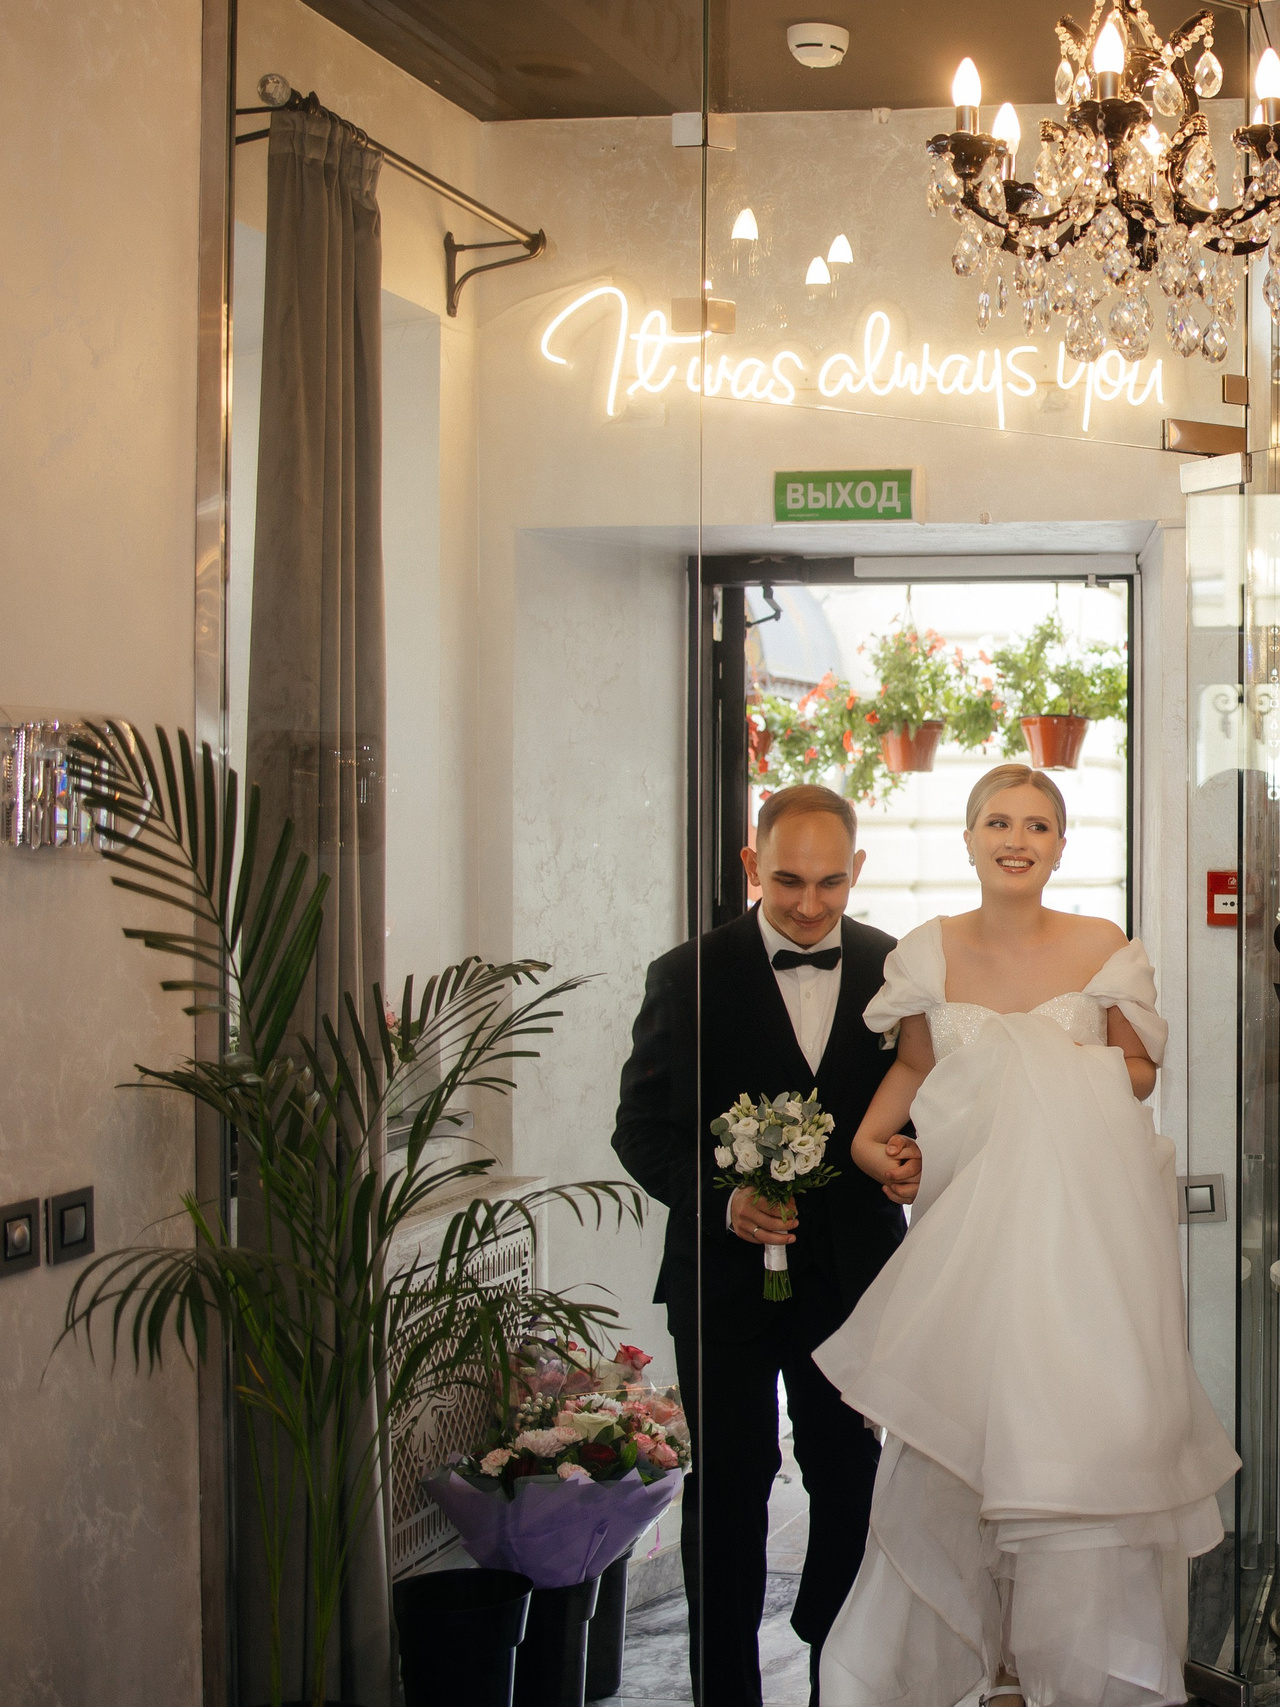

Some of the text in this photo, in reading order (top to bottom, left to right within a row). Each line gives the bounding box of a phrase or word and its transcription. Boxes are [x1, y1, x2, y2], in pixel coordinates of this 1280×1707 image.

[541, 286, 1164, 432] It was always you
[786, 481, 901, 513] ВЫХОД
